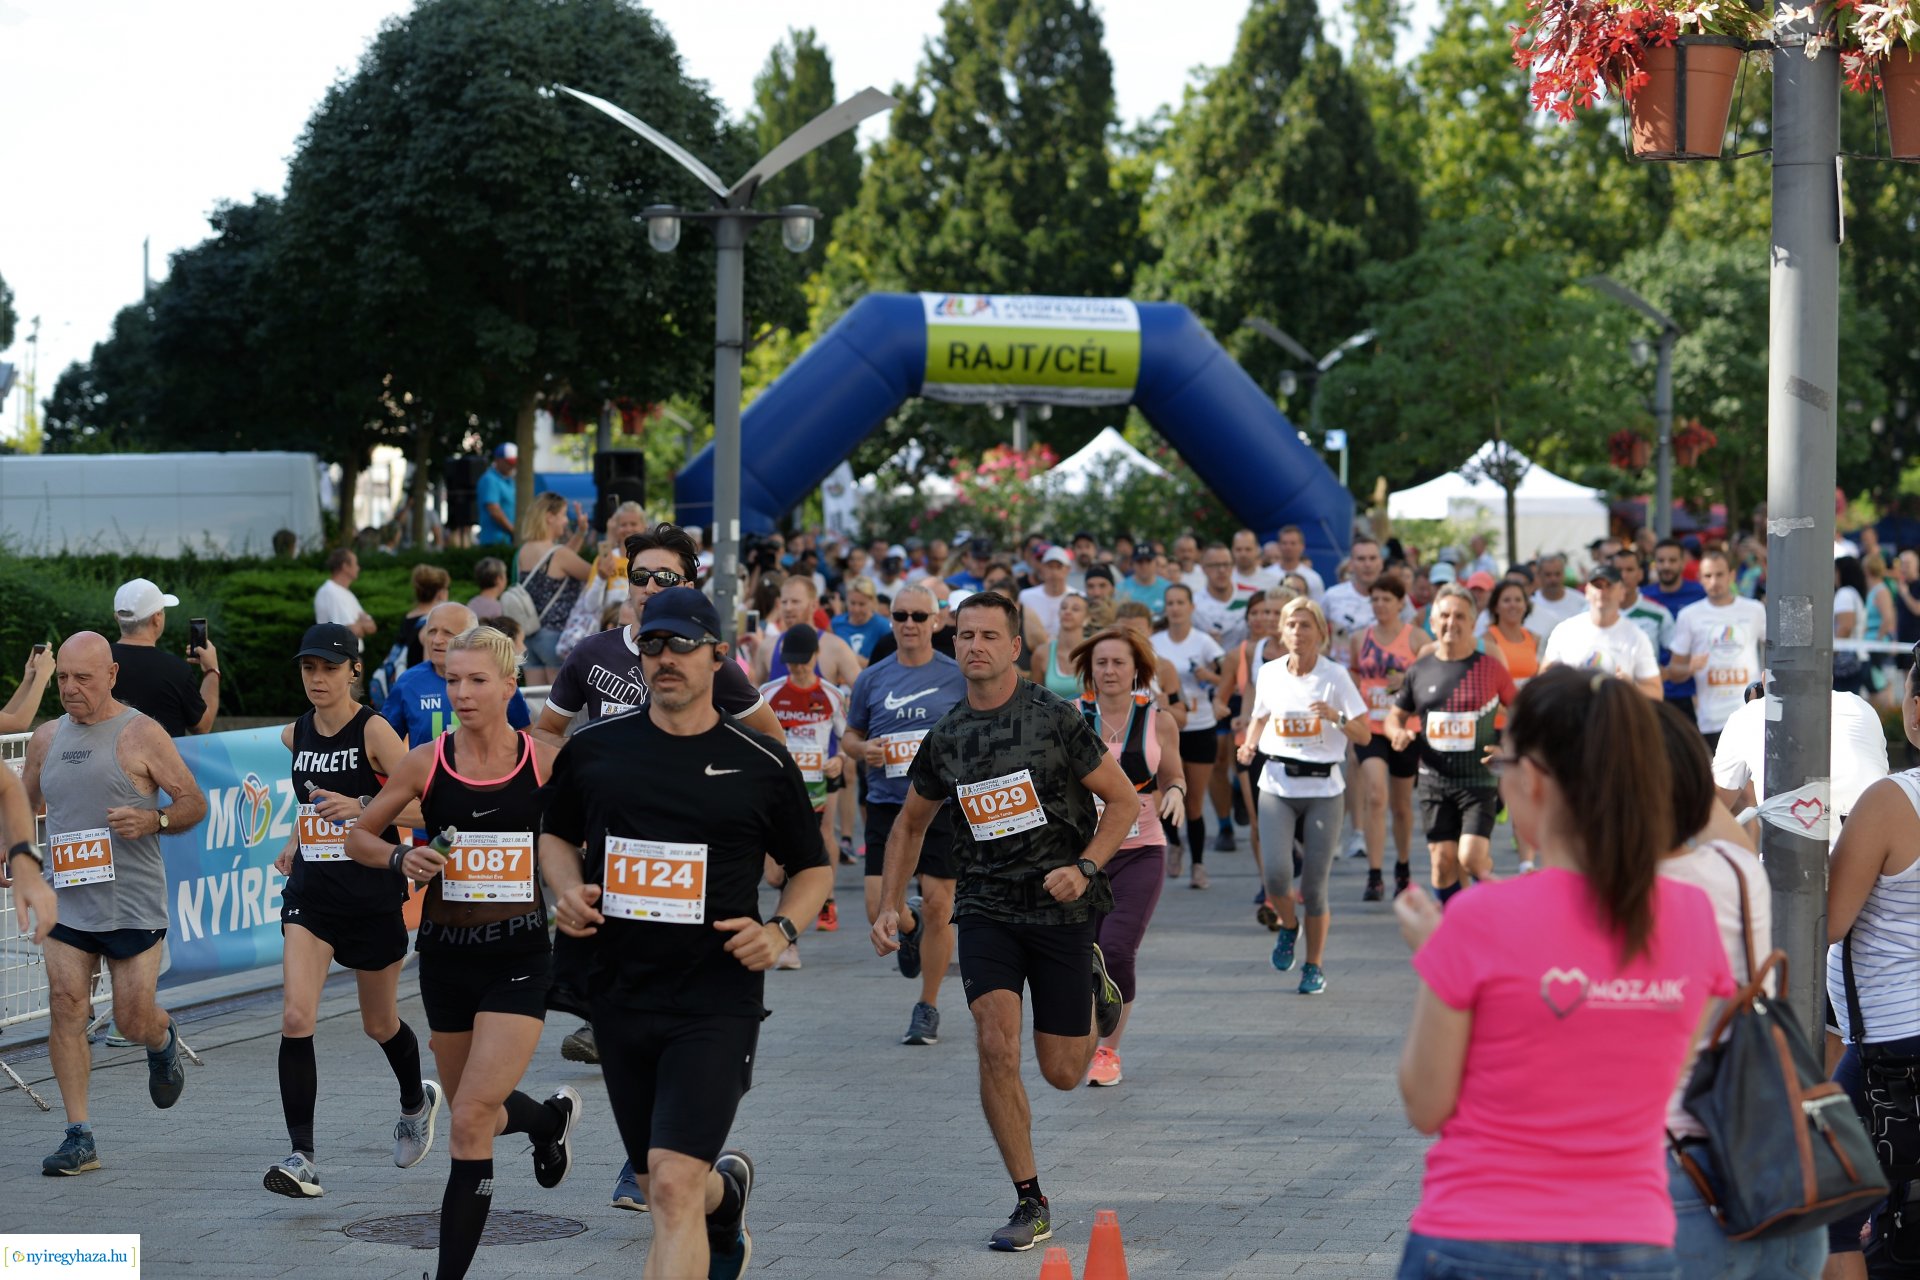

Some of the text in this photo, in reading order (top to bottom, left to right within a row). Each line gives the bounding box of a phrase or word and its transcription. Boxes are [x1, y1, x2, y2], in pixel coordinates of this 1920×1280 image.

[948, 338, 1116, 375] RAJT/CÉL
[587, 665, 641, 705] PUMA
[420, 697, 441, 710] NN
[896, 707, 926, 719] AIR
[775, 710, 826, 722] HUNGARY
[1276, 719, 1316, 733] 1137
[792, 727, 816, 737] OCR
[61, 750, 93, 760] SAUCONY
[293, 748, 359, 773] ATHLETE
[967, 786, 1027, 816] 1029
[55, 841, 104, 865] 1144
[449, 848, 523, 872] 1087
[614, 857, 694, 889] 1124
[439, 921, 502, 945] NIKE
